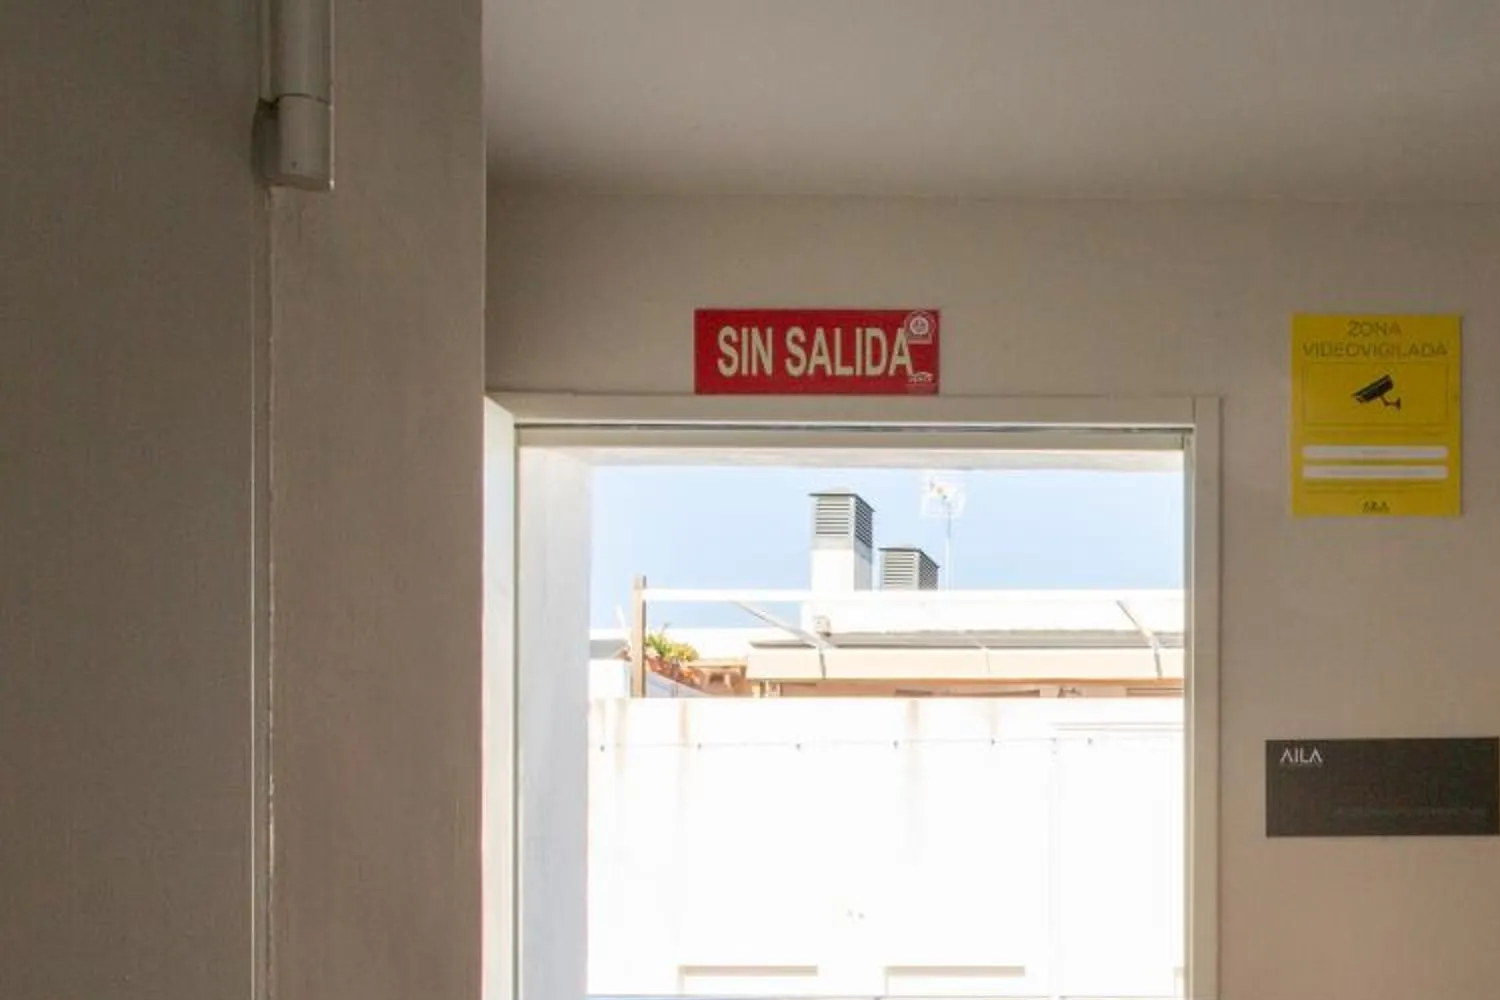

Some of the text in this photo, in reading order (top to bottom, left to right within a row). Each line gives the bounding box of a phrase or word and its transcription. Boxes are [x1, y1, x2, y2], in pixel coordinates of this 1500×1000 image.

[1348, 320, 1402, 336] ZONA
[717, 325, 913, 378] SIN SALIDA
[1302, 342, 1449, 358] VIDEOVIGILADA
[1280, 747, 1323, 764] AILA
